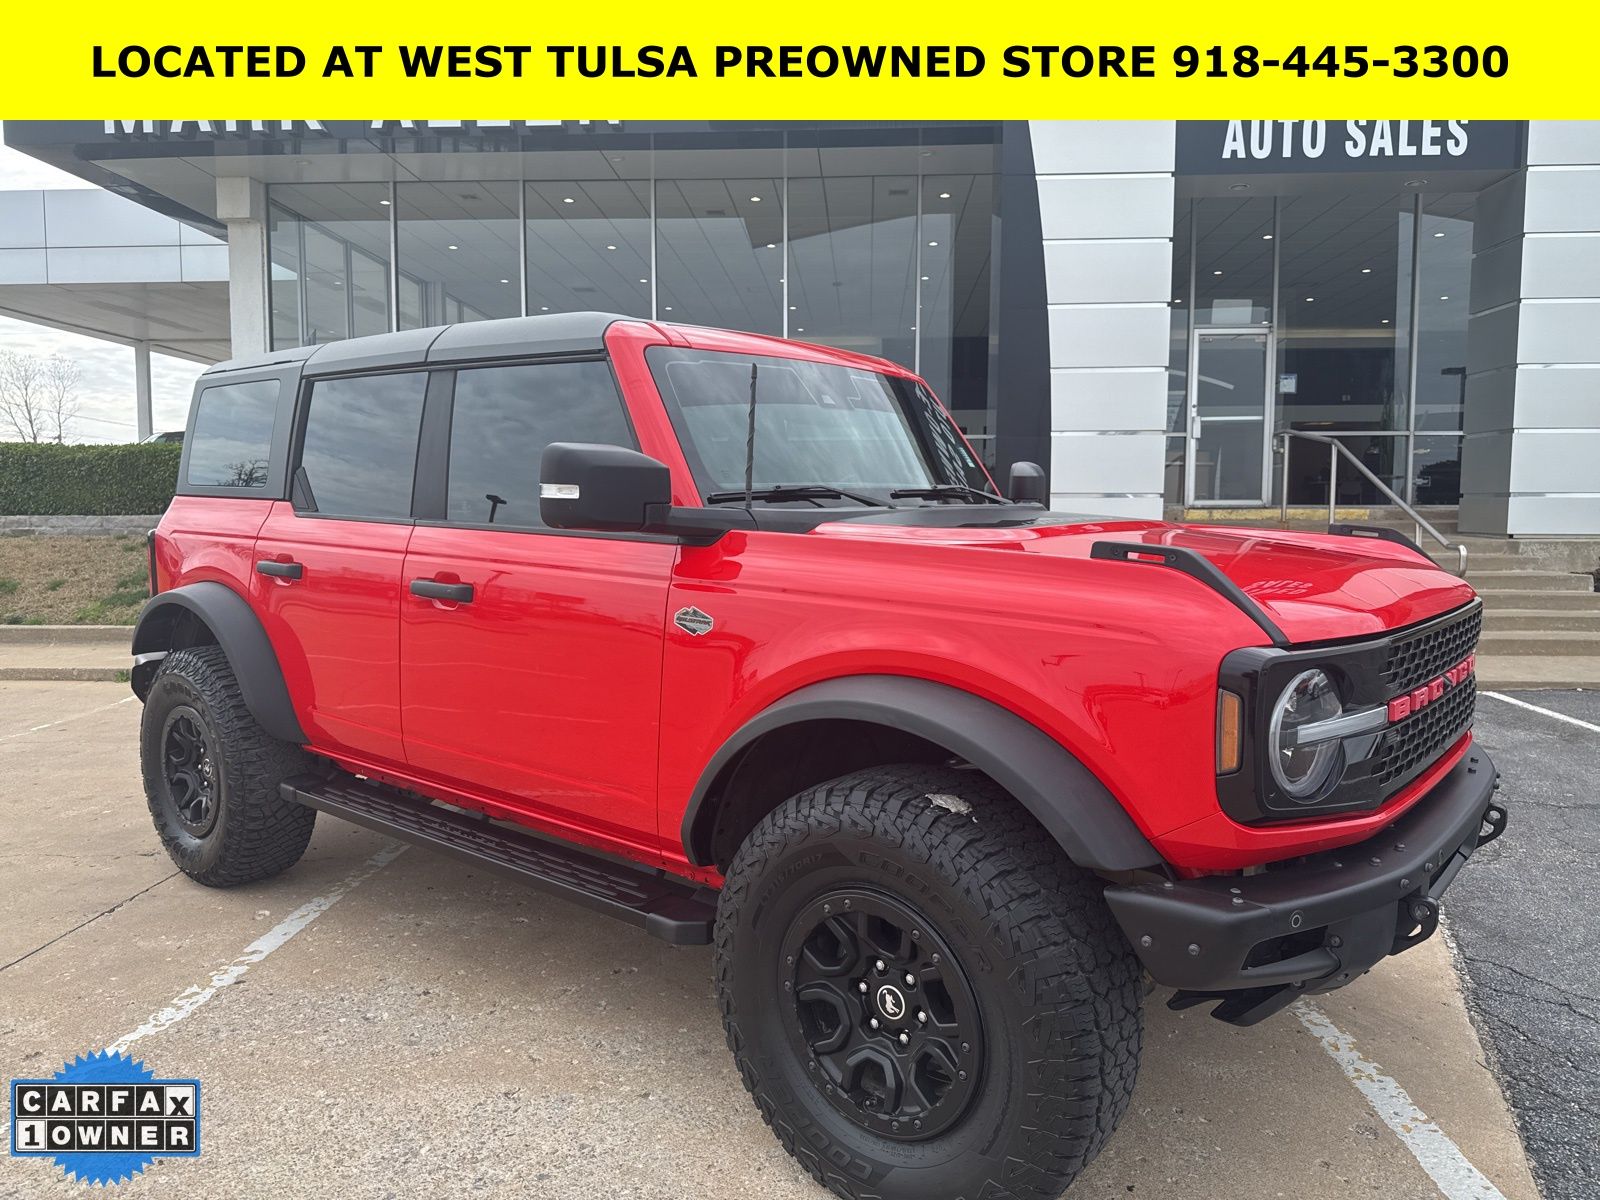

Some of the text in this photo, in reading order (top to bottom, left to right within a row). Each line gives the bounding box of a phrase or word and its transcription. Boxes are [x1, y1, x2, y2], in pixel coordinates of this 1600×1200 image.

[1221, 120, 1469, 159] AUTO SALES
[1388, 653, 1475, 722] BRONCO
